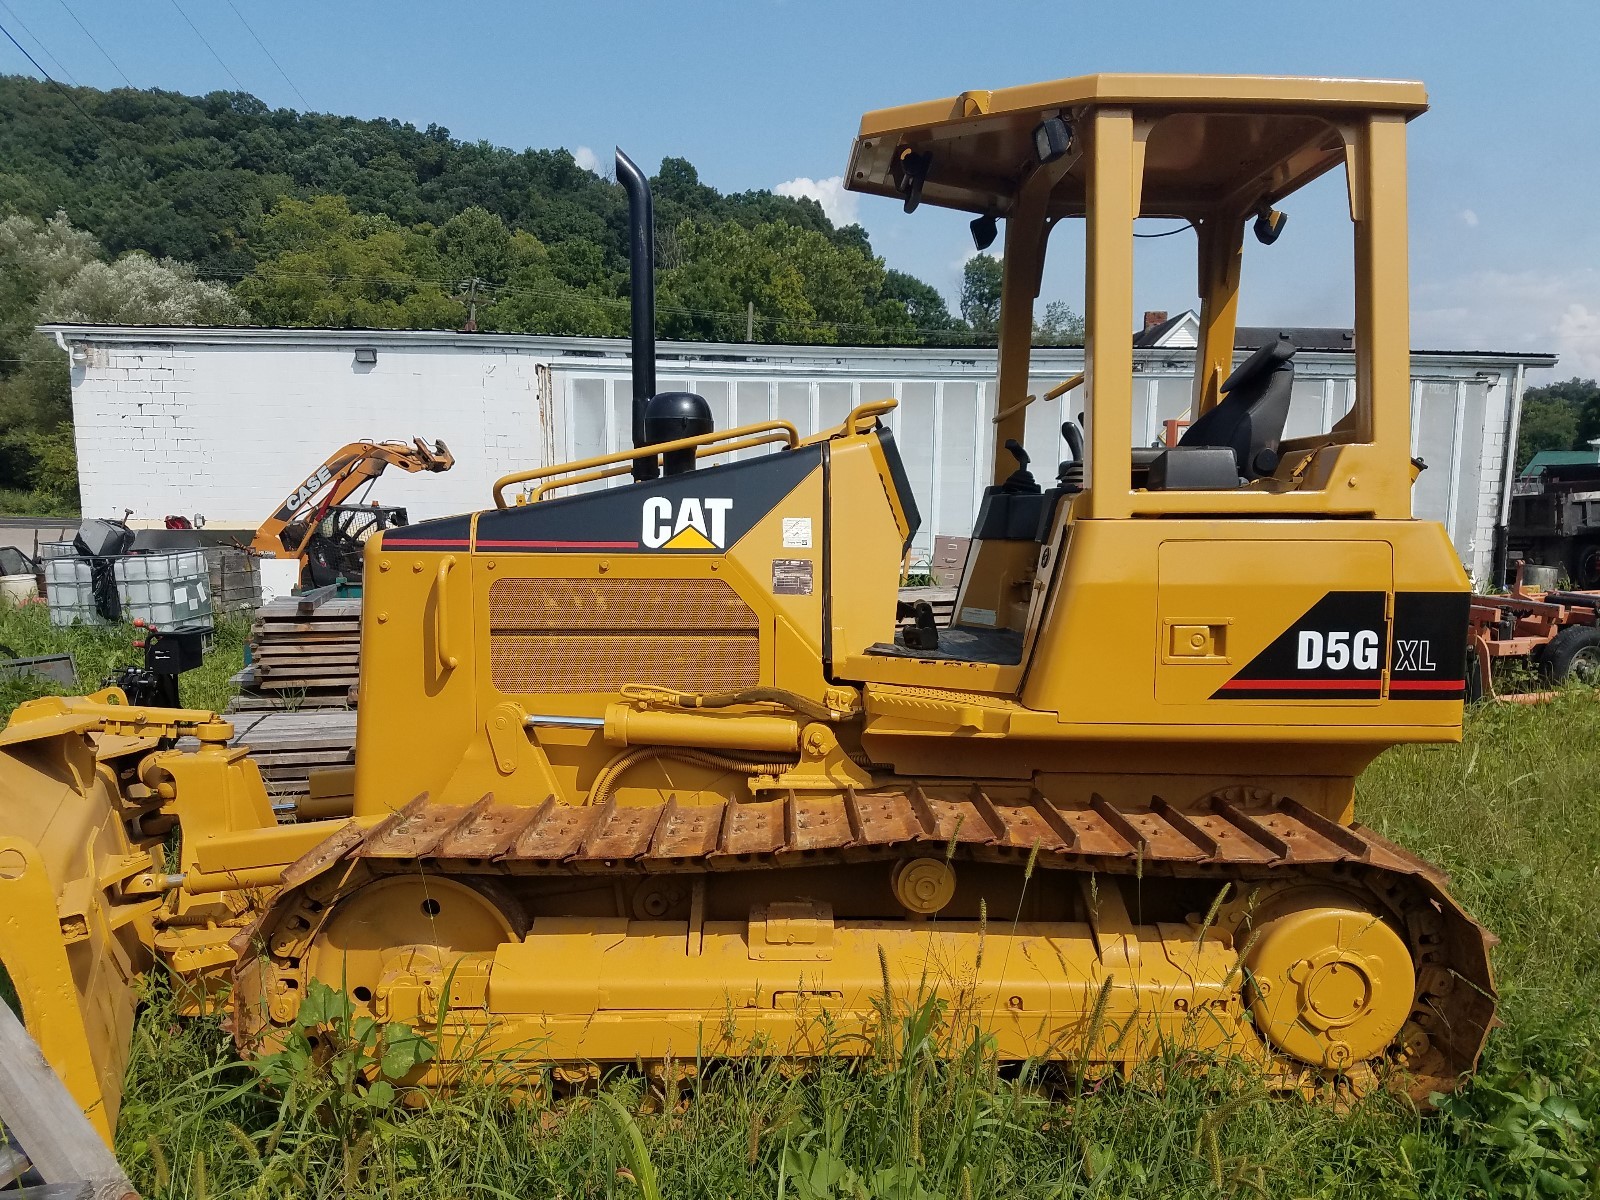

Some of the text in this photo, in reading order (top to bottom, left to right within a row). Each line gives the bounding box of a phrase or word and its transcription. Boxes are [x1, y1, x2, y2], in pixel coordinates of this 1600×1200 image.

[286, 465, 332, 511] CASE
[642, 496, 733, 549] CAT
[1297, 630, 1437, 671] D5G XL
